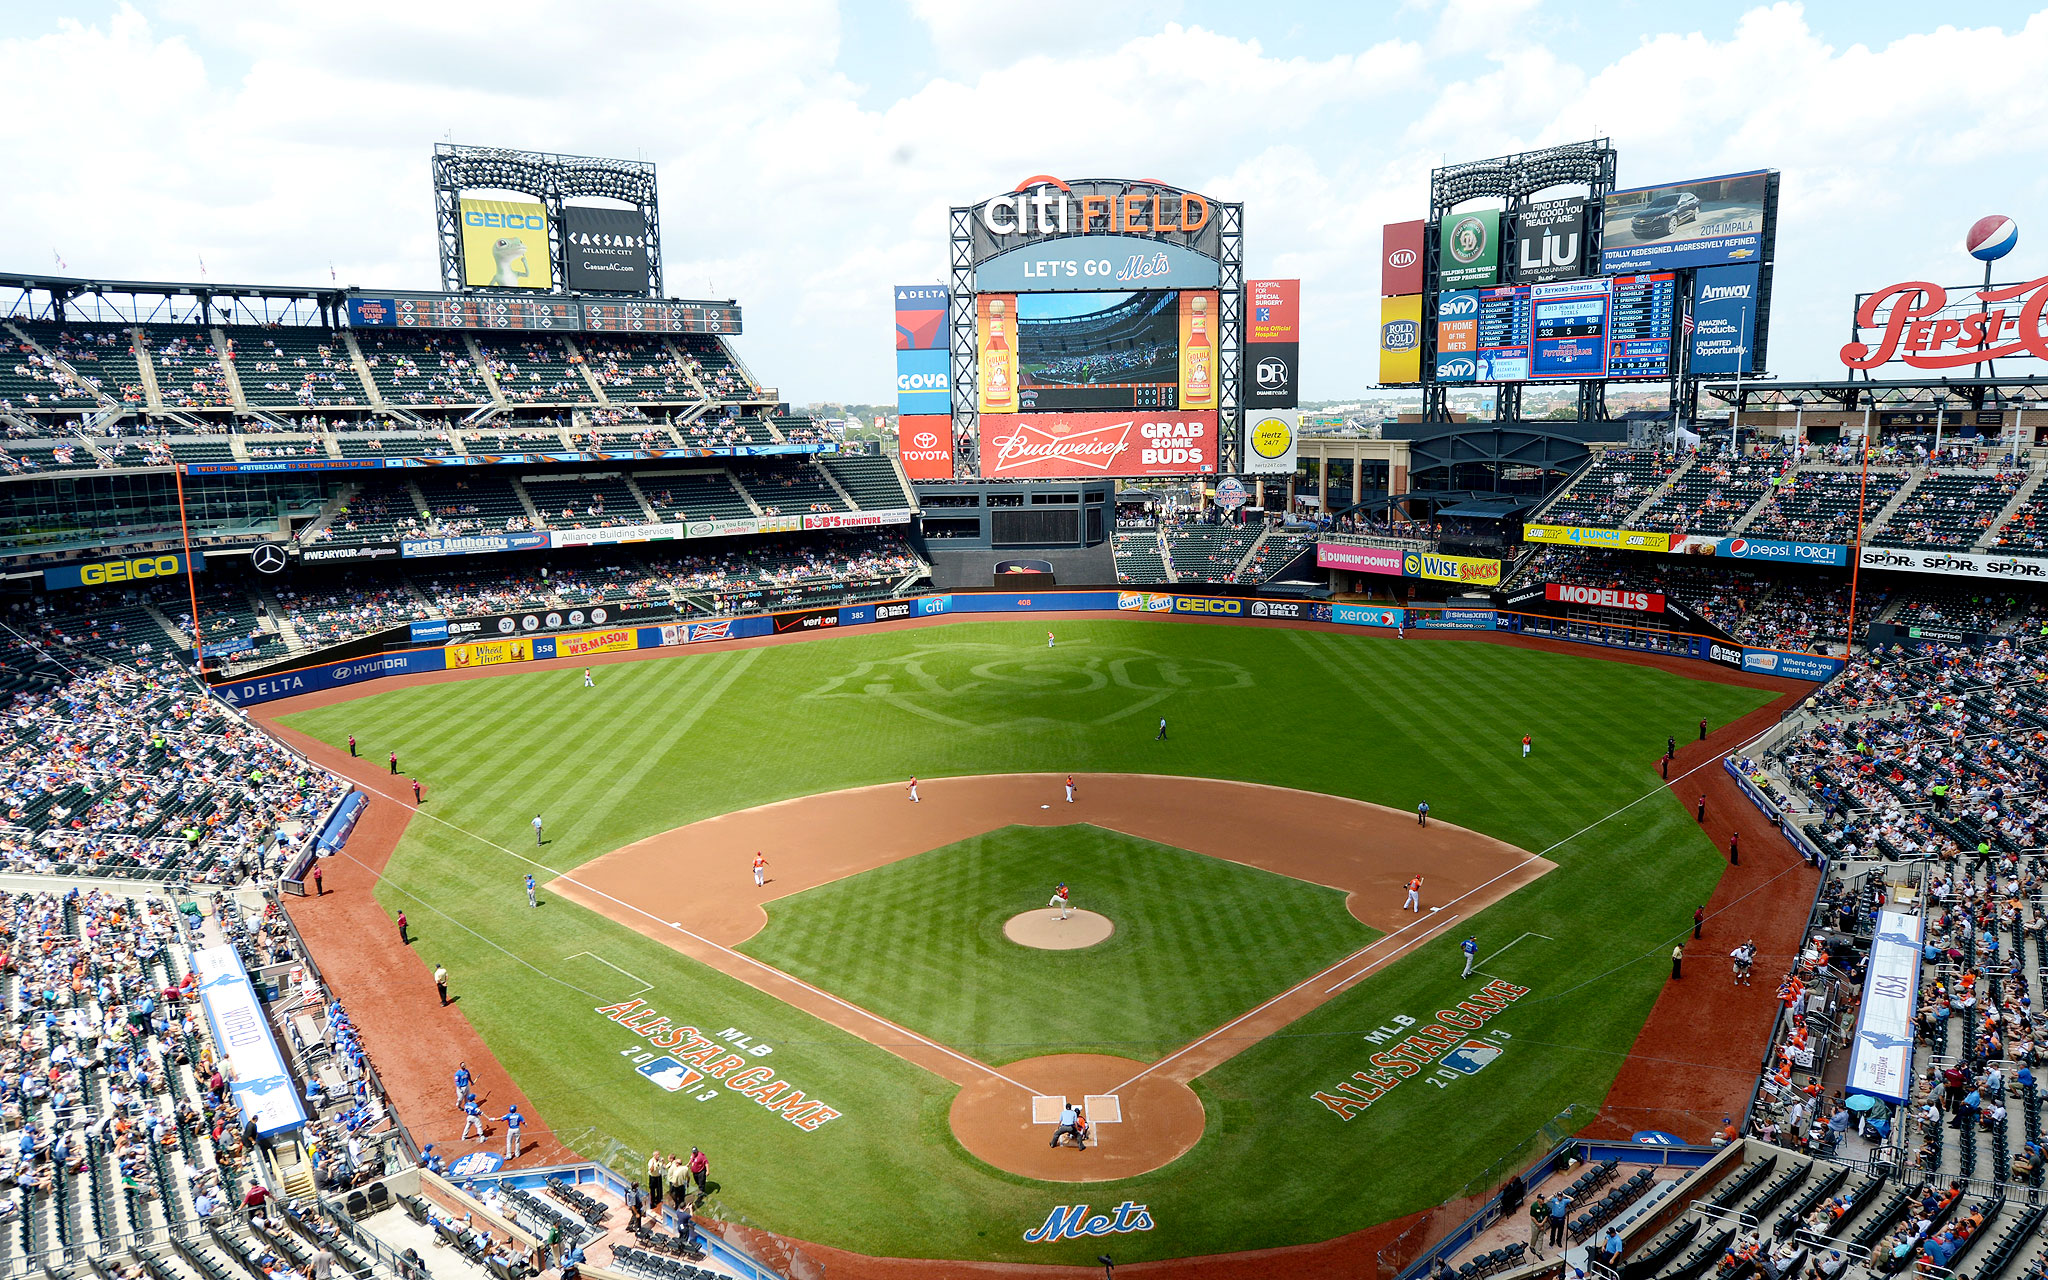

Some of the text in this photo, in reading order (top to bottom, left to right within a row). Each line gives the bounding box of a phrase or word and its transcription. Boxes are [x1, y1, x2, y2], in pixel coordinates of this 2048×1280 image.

[984, 185, 1208, 234] citi FIELD
[1520, 205, 1583, 220] HOW GOOD YOU
[1533, 202, 1551, 211] FIND
[465, 211, 543, 230] GEICO
[1526, 215, 1574, 227] REALLY ARE.
[1701, 221, 1753, 236] 2014 IMPALA
[569, 232, 645, 248] CAESARS
[1521, 233, 1578, 269] LIU
[1605, 237, 1756, 259] TOTALLY REDESIGNED. AGGRESSIVELY REFINED.
[1394, 253, 1411, 264] KIA
[584, 262, 633, 271] CaesarsAC.com
[1024, 252, 1171, 280] LET'S GO Mets
[1441, 268, 1464, 276] HELPING
[1606, 261, 1651, 270] ChevyOffers.com
[1701, 285, 1750, 298] Amway
[1439, 302, 1471, 315] SNY
[1390, 324, 1413, 333] ROLD
[1453, 322, 1472, 330] HOME
[1697, 325, 1737, 334] Products.
[1387, 333, 1414, 345] GOLD
[1448, 342, 1466, 350] METS
[1257, 364, 1286, 383] DR
[1437, 365, 1469, 377] SNY
[898, 374, 947, 390] GOYA
[1140, 422, 1204, 438] GRAB
[992, 436, 1128, 459] Budweiser
[1152, 438, 1193, 448] SOME
[467, 456, 487, 465] USA
[524, 454, 544, 463] USA
[581, 453, 599, 461] USA
[902, 451, 949, 460] TOYOTA
[1142, 448, 1203, 464] BUDS
[404, 458, 424, 467] USA
[806, 515, 841, 528] BOB'S
[843, 517, 880, 525] FURNITURE
[561, 527, 674, 541] Alliance Building Services
[1528, 529, 1665, 546] SUBWAY LUNCH SUBWAY
[404, 537, 508, 551] Parts Authority
[304, 549, 357, 560] #WEARYOUR
[1795, 546, 1835, 560] PORCH
[1328, 554, 1399, 568] DUNKIN' DONUTS
[80, 556, 179, 585] GEICO
[1424, 557, 1499, 581] WISE SNACKS
[1120, 597, 1141, 608] Gulf
[1560, 586, 1648, 610] MODELL'S
[926, 601, 943, 613] citi
[1149, 599, 1170, 611] Gulf
[1176, 598, 1240, 614] GEICO
[804, 616, 837, 626] verizon
[1340, 610, 1378, 622] xerox
[503, 621, 512, 630] 37
[527, 619, 535, 627] 14
[475, 644, 503, 657] Wheat
[537, 645, 553, 653] 358
[1721, 648, 1740, 657] TACO
[476, 655, 503, 665] Thins
[1722, 654, 1740, 664] BELL
[1747, 657, 1775, 666] StubHub!
[1783, 658, 1805, 666] Where
[354, 658, 407, 675] HYUNDAI
[1810, 668, 1822, 676] sit?
[244, 677, 303, 699] DELTA
[1875, 974, 1908, 999] USA
[1435, 978, 1531, 1029] GAME
[222, 1006, 260, 1047] WORLD
[1364, 1014, 1416, 1045] MLB
[716, 1027, 773, 1057] MLB
[724, 1066, 842, 1131] GAME
[1023, 1201, 1156, 1243] Mets
